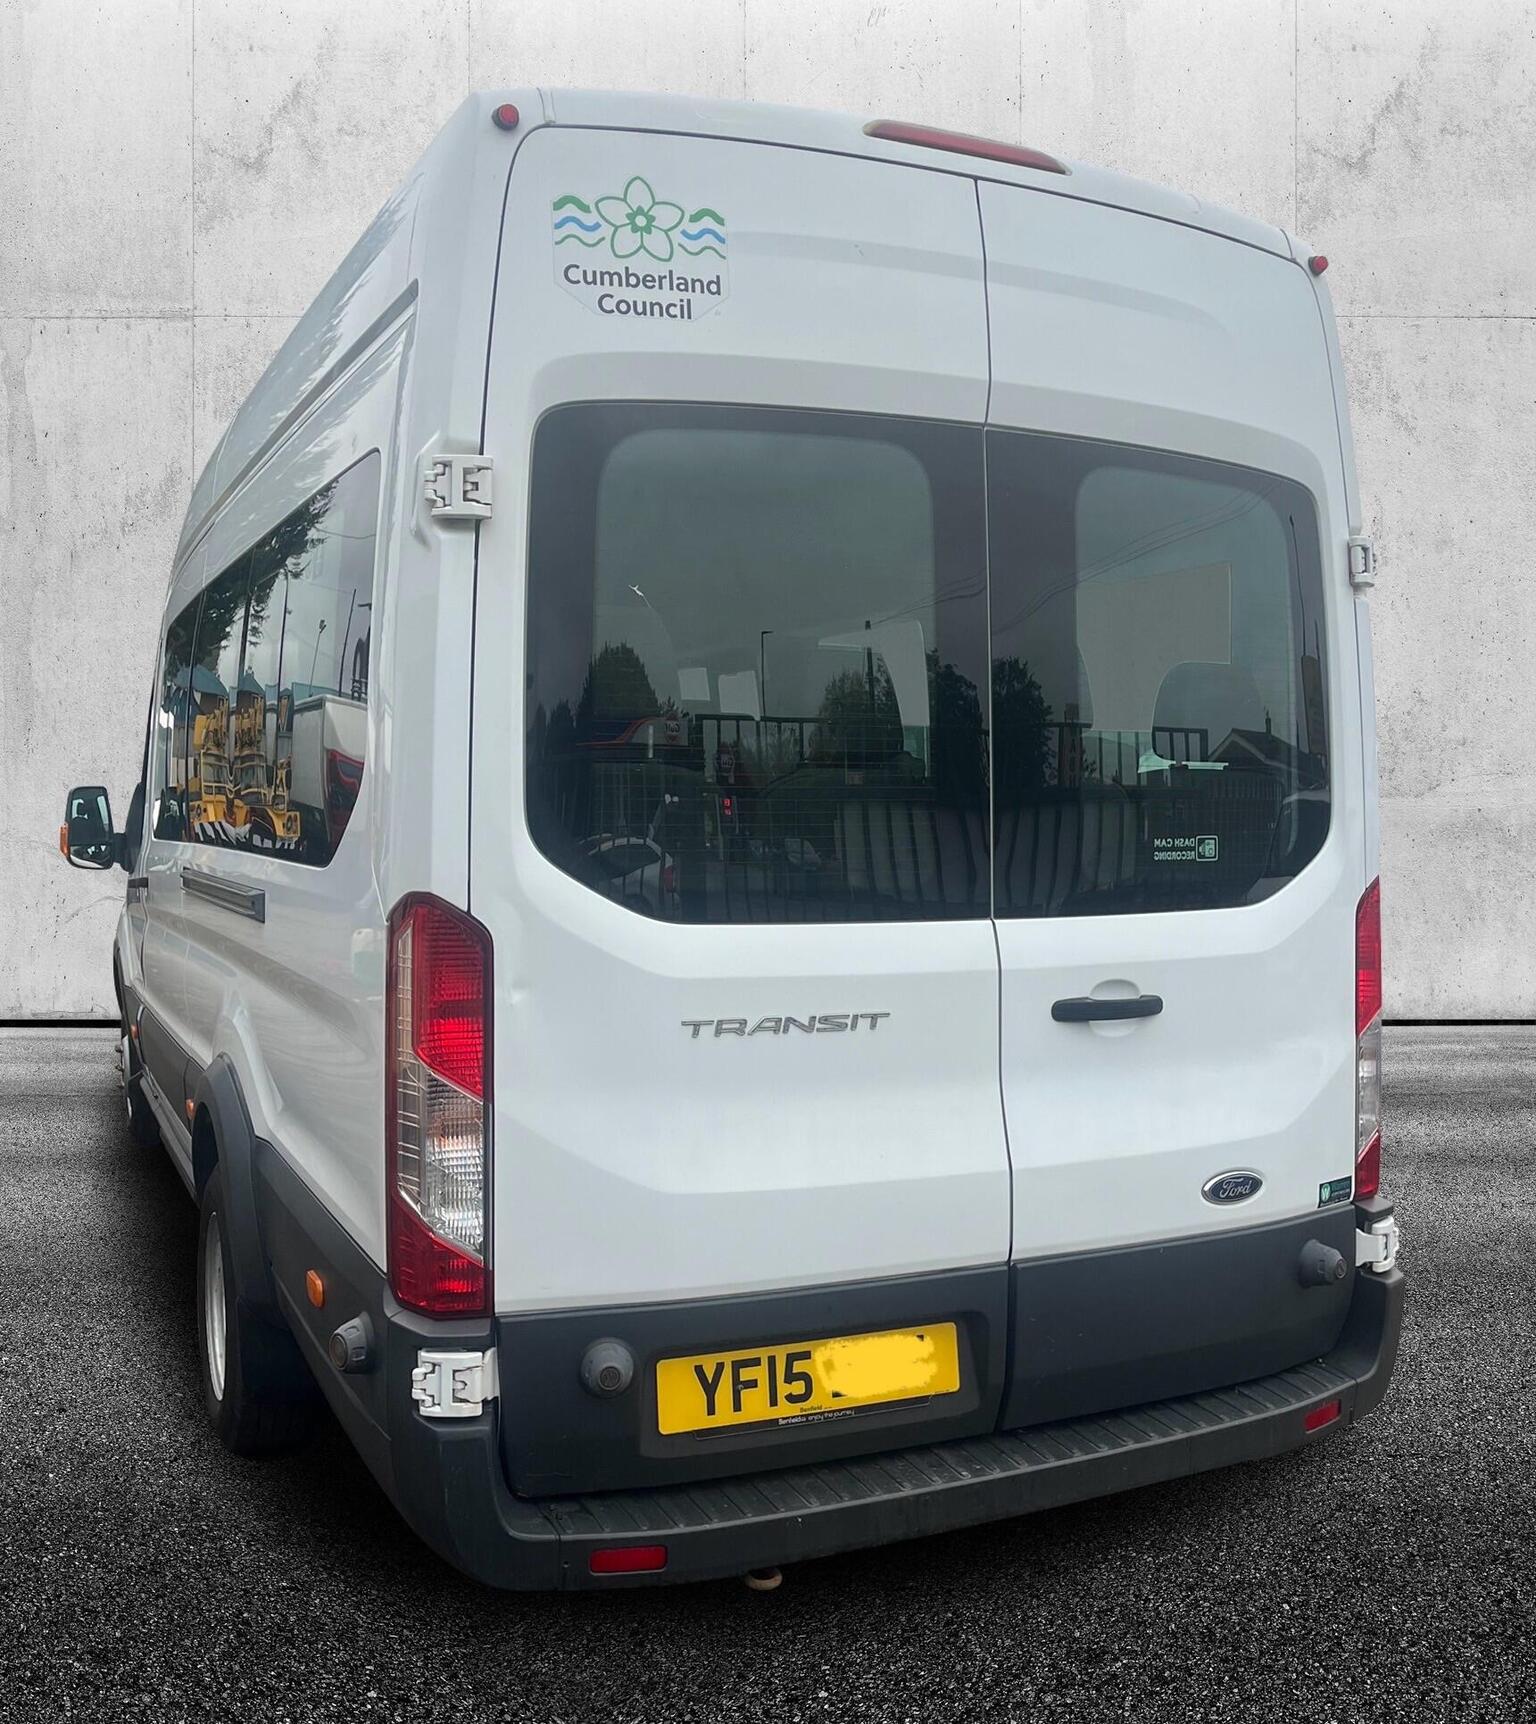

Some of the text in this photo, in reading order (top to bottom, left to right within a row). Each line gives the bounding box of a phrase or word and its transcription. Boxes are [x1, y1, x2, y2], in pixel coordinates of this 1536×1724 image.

[563, 263, 721, 296] Cumberland
[597, 293, 692, 320] Council
[681, 1012, 891, 1039] TRANSIT
[1219, 1177, 1252, 1198] Ford
[693, 1350, 814, 1417] YF15
